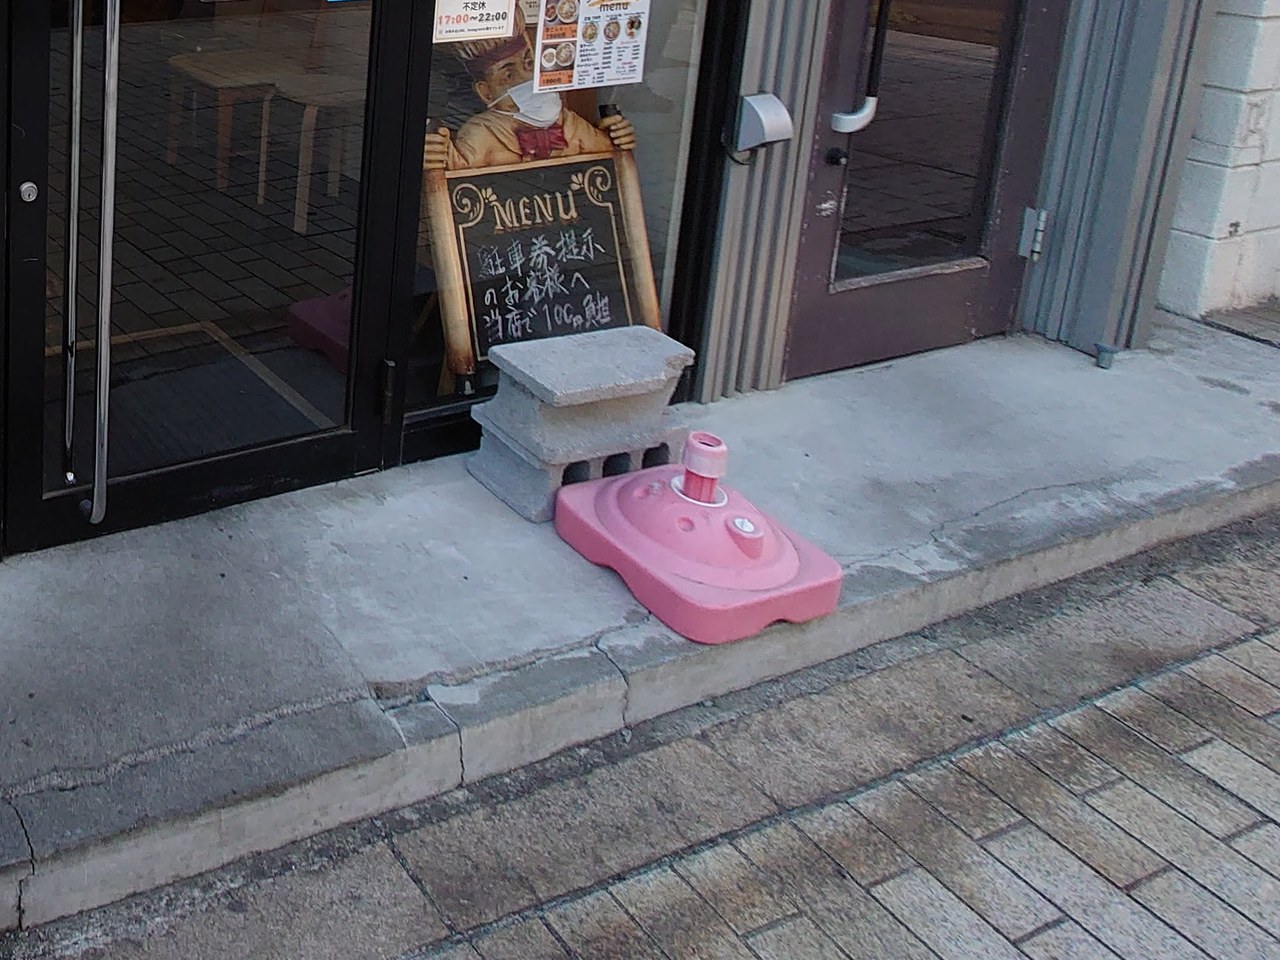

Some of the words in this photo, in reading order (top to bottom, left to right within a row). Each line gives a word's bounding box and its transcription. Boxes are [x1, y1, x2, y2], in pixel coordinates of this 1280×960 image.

[462, 1, 487, 11] 不定休
[599, 2, 629, 12] menu
[490, 190, 580, 232] MENU
[476, 227, 605, 279] 駐車券提示
[484, 267, 590, 307] のお客様へ
